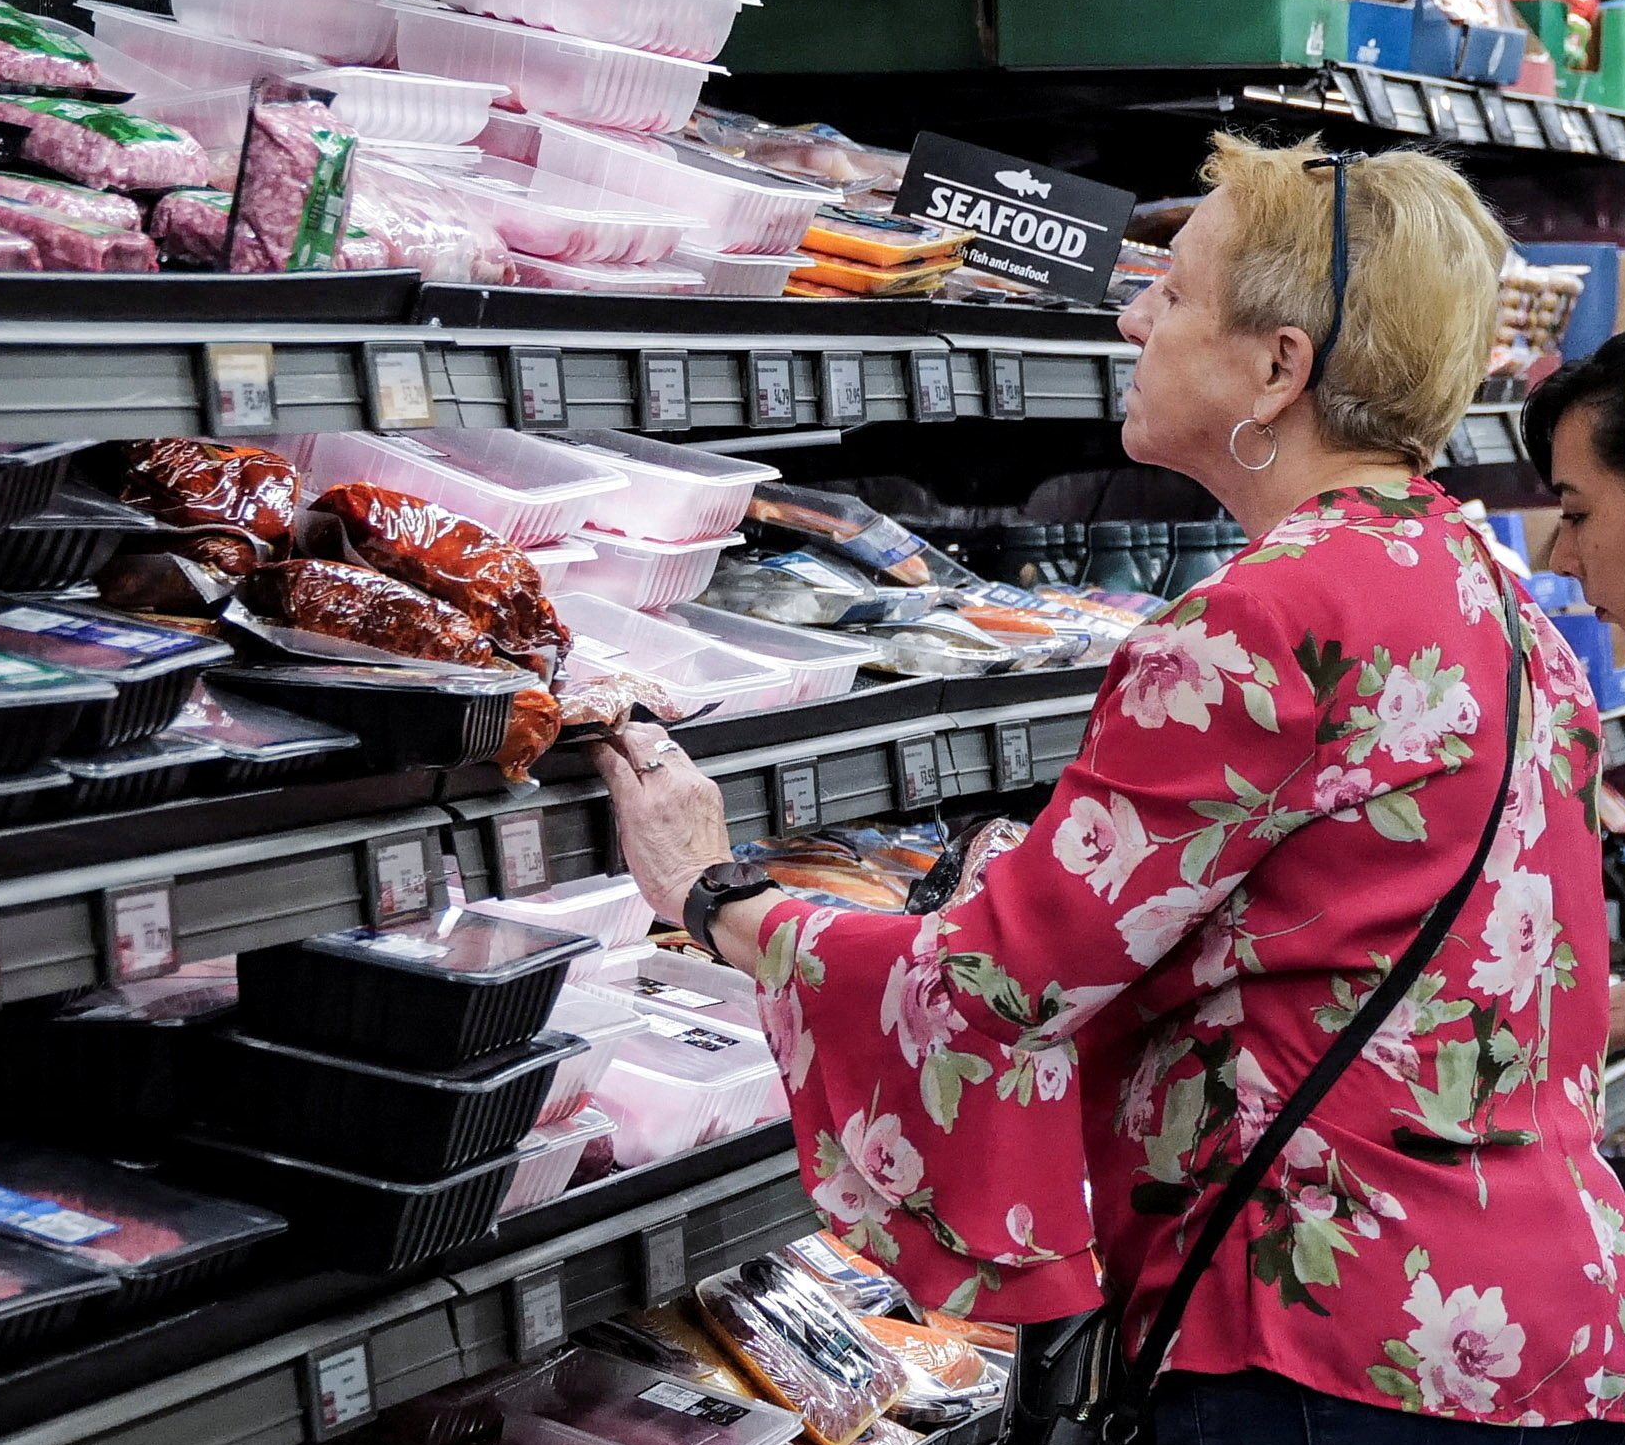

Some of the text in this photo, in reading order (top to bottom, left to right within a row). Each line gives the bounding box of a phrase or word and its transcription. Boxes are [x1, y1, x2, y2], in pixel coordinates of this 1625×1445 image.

[926, 186, 1087, 258] SEAFOOD
[969, 247, 988, 265] fish
[988, 256, 1008, 272] and
[1008, 263, 1050, 284] seafood.
